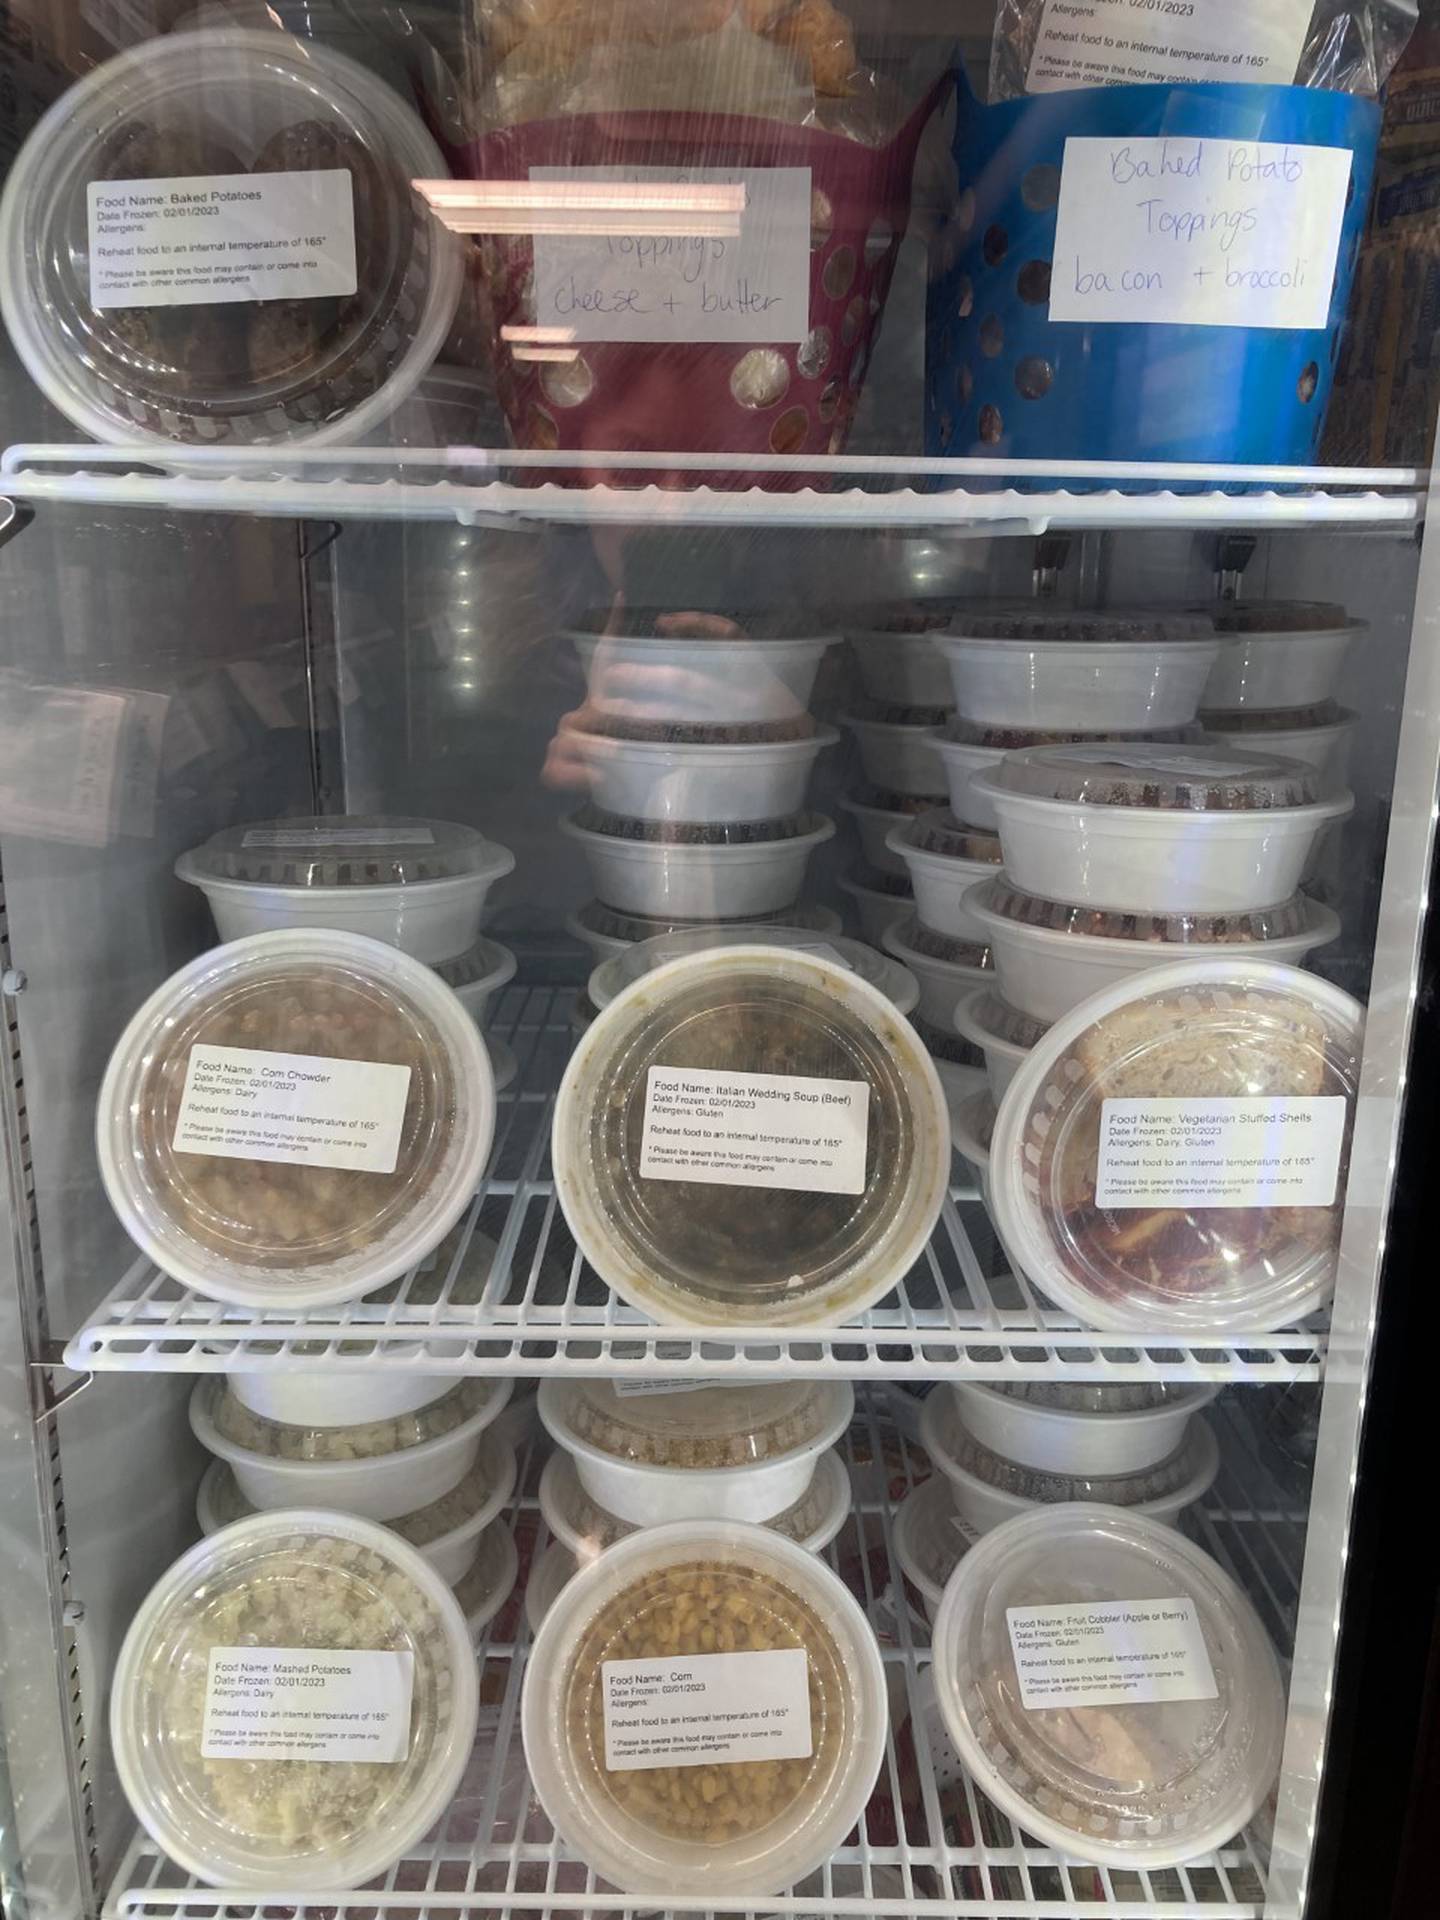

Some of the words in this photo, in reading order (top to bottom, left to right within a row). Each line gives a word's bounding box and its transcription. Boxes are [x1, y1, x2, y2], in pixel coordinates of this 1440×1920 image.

[1045, 29, 1079, 41] Reheat
[1081, 33, 1102, 45] food
[1104, 37, 1114, 47] to
[1115, 40, 1129, 49] an
[1130, 41, 1168, 54] internal
[1169, 47, 1229, 62] temperature
[1231, 54, 1244, 64] of
[1044, 56, 1070, 66] Please
[1084, 62, 1109, 72] aware
[1127, 67, 1147, 78] food
[1147, 73, 1165, 82] may
[1227, 146, 1303, 182] Potato
[96, 196, 126, 208] Food
[128, 195, 167, 206] Name:
[170, 193, 207, 204] Baked
[210, 191, 262, 201] Potatoes
[96, 211, 121, 222] Date
[122, 209, 160, 220] Frozen:
[163, 205, 219, 218] 02/01/2023
[1136, 199, 1257, 251] Toppings
[97, 247, 134, 257] Reheat
[136, 245, 159, 255] food
[161, 245, 171, 254] to
[173, 245, 187, 253] an
[189, 241, 226, 252] internal
[228, 240, 289, 251] temperature
[290, 237, 301, 247] of
[1075, 255, 1162, 293] bacon
[1194, 266, 1213, 286] +
[1225, 257, 1306, 288] broccoli
[555, 276, 652, 313] cheese
[663, 293, 681, 314] +
[702, 279, 783, 314] butter
[196, 1060, 221, 1072] Food
[287, 1070, 331, 1083] Chowder
[193, 1072, 214, 1082] Date
[249, 1078, 296, 1091] 02/01/2023
[234, 1088, 258, 1099] Dairy
[652, 1092, 673, 1103] Date
[674, 1094, 707, 1105] Frozen:
[708, 1097, 756, 1109] 02/01/2023
[654, 1080, 679, 1091] Food
[681, 1083, 713, 1094] Name:
[716, 1085, 745, 1096] Italian
[747, 1087, 791, 1101] Wedding
[793, 1091, 819, 1103] Soup
[821, 1093, 851, 1105] (Beef)
[187, 1103, 219, 1113] Reheat
[220, 1106, 239, 1116] food
[240, 1109, 249, 1117] to
[250, 1110, 262, 1118] an
[263, 1110, 295, 1121] internal
[296, 1115, 347, 1127] temperature
[348, 1120, 358, 1128] of
[695, 1107, 723, 1118] Gluten
[1109, 1114, 1137, 1125] Food
[1139, 1114, 1175, 1124] Name:
[1178, 1113, 1235, 1124] Vegetarian
[1238, 1113, 1276, 1123] Stuffed
[1278, 1112, 1312, 1123] Shells
[649, 1124, 680, 1136] Reheat
[682, 1127, 701, 1137] food
[703, 1129, 712, 1137] to
[726, 1130, 758, 1141] internal
[759, 1133, 810, 1145] temperature
[812, 1138, 821, 1146] of
[1108, 1127, 1130, 1136] Date
[1132, 1126, 1168, 1136] Frozen:
[1168, 1126, 1221, 1135] 02/01/2023
[1184, 1138, 1215, 1147] Gluten
[1106, 1158, 1139, 1166] Reheat
[1142, 1158, 1162, 1166] food
[1164, 1158, 1174, 1166] to
[1189, 1158, 1224, 1166] internal
[1225, 1158, 1280, 1166] temperature
[1281, 1157, 1293, 1166] of
[215, 1661, 239, 1672] Food
[272, 1663, 309, 1674] Mashed
[311, 1664, 351, 1674] Potatoes
[213, 1674, 236, 1685] Date
[274, 1676, 325, 1687] 02/01/2023
[609, 1675, 633, 1685] Food
[253, 1688, 274, 1699] Dairy
[609, 1688, 629, 1697] Date
[661, 1682, 706, 1694] 02/01/2023
[210, 1708, 239, 1717] Reheat
[240, 1709, 259, 1718] food
[260, 1710, 268, 1718] to
[312, 1712, 359, 1720] temperature
[360, 1712, 370, 1721] of
[611, 1719, 640, 1728] Reheat
[641, 1717, 659, 1726] food
[660, 1717, 668, 1725] to
[682, 1713, 711, 1723] internal
[712, 1712, 759, 1721] temperature
[761, 1709, 769, 1718] of
